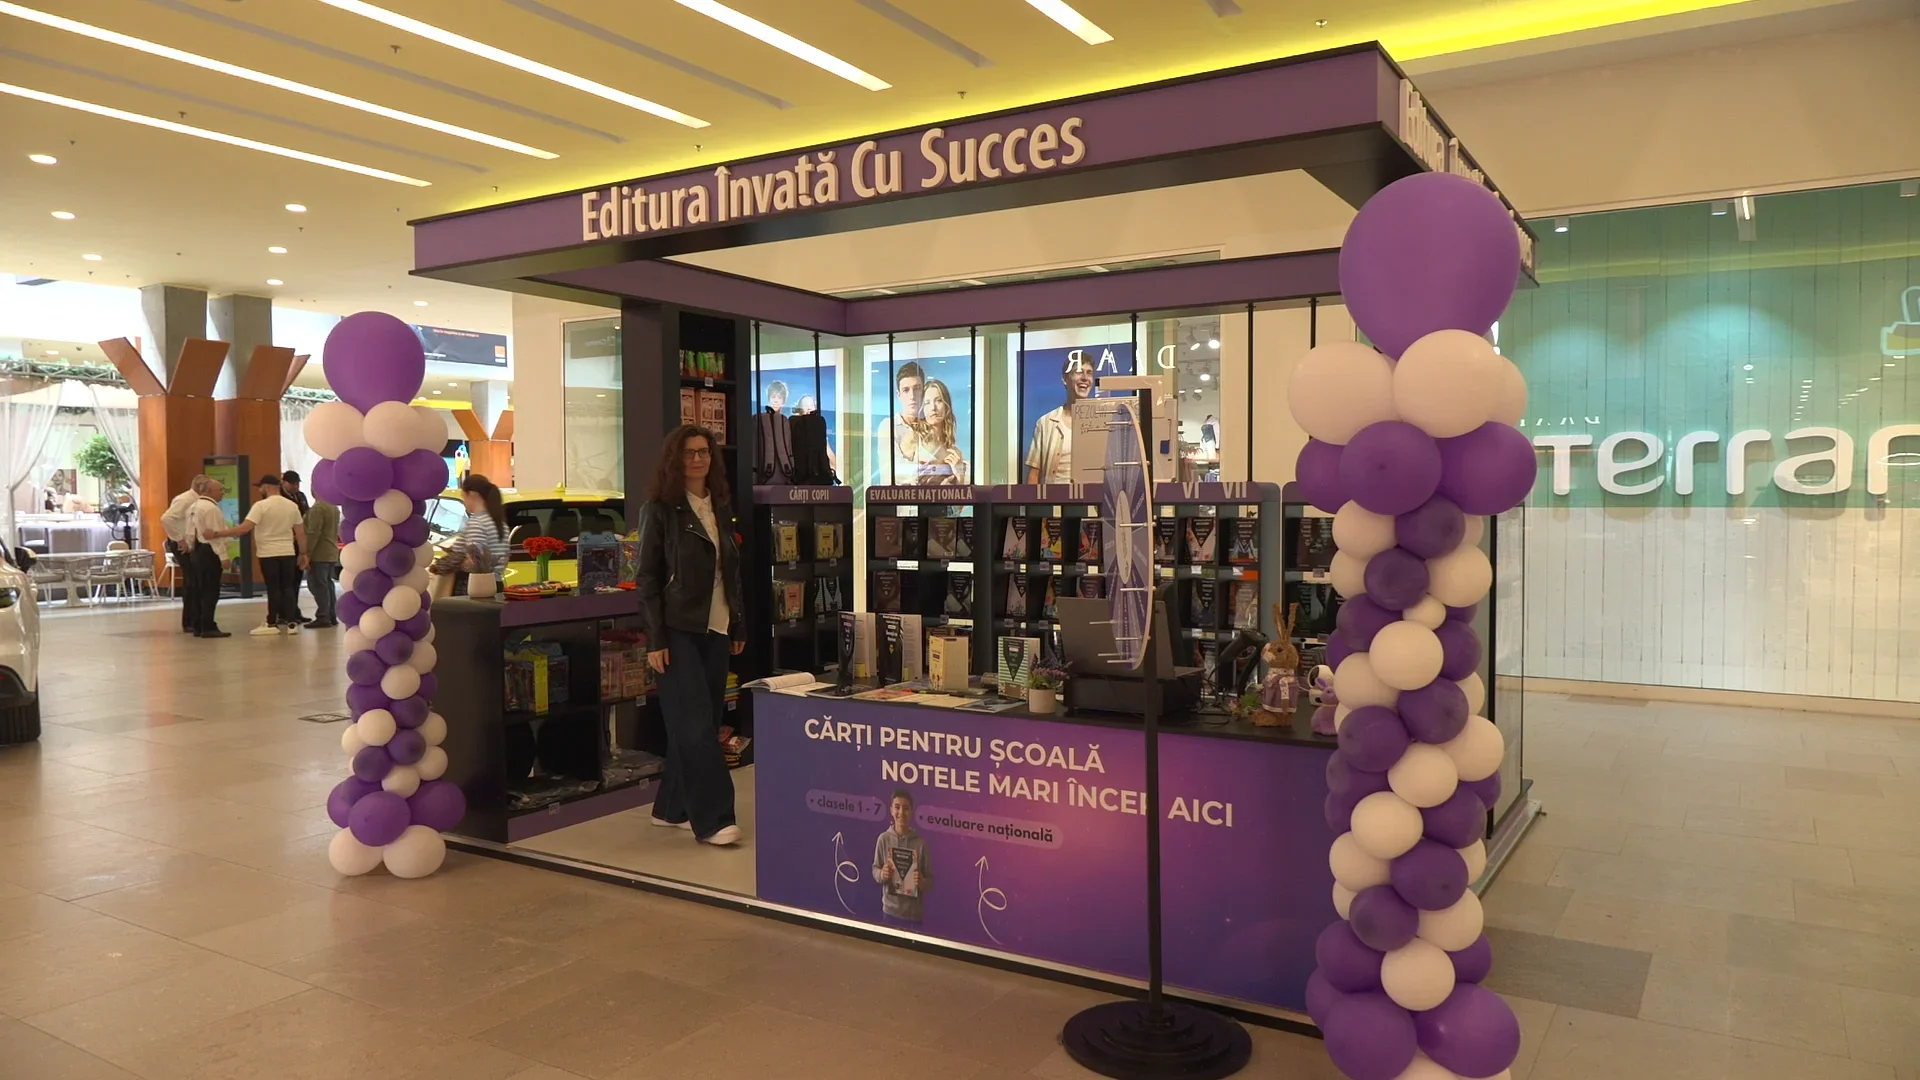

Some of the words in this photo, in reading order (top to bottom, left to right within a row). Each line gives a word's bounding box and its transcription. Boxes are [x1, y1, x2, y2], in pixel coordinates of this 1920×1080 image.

[582, 185, 710, 242] Editura
[714, 151, 840, 222] Învață
[851, 140, 902, 198] Cu
[920, 117, 1086, 189] Succes
[812, 489, 830, 501] COPII
[870, 488, 916, 501] EVALUARE
[918, 487, 973, 503] NAȚIONALĂ
[1182, 482, 1200, 499] VI
[1222, 482, 1247, 499] VII
[804, 715, 872, 752] CĂRȚI
[880, 727, 982, 759] PENTRU
[989, 739, 1106, 774] ȘCOALĂ
[817, 796, 855, 813] clasele
[881, 759, 981, 793] NOTELE
[988, 773, 1059, 804] MARI
[1167, 796, 1233, 828] AICI
[927, 814, 985, 833] evaluare
[987, 824, 1054, 843] națională
